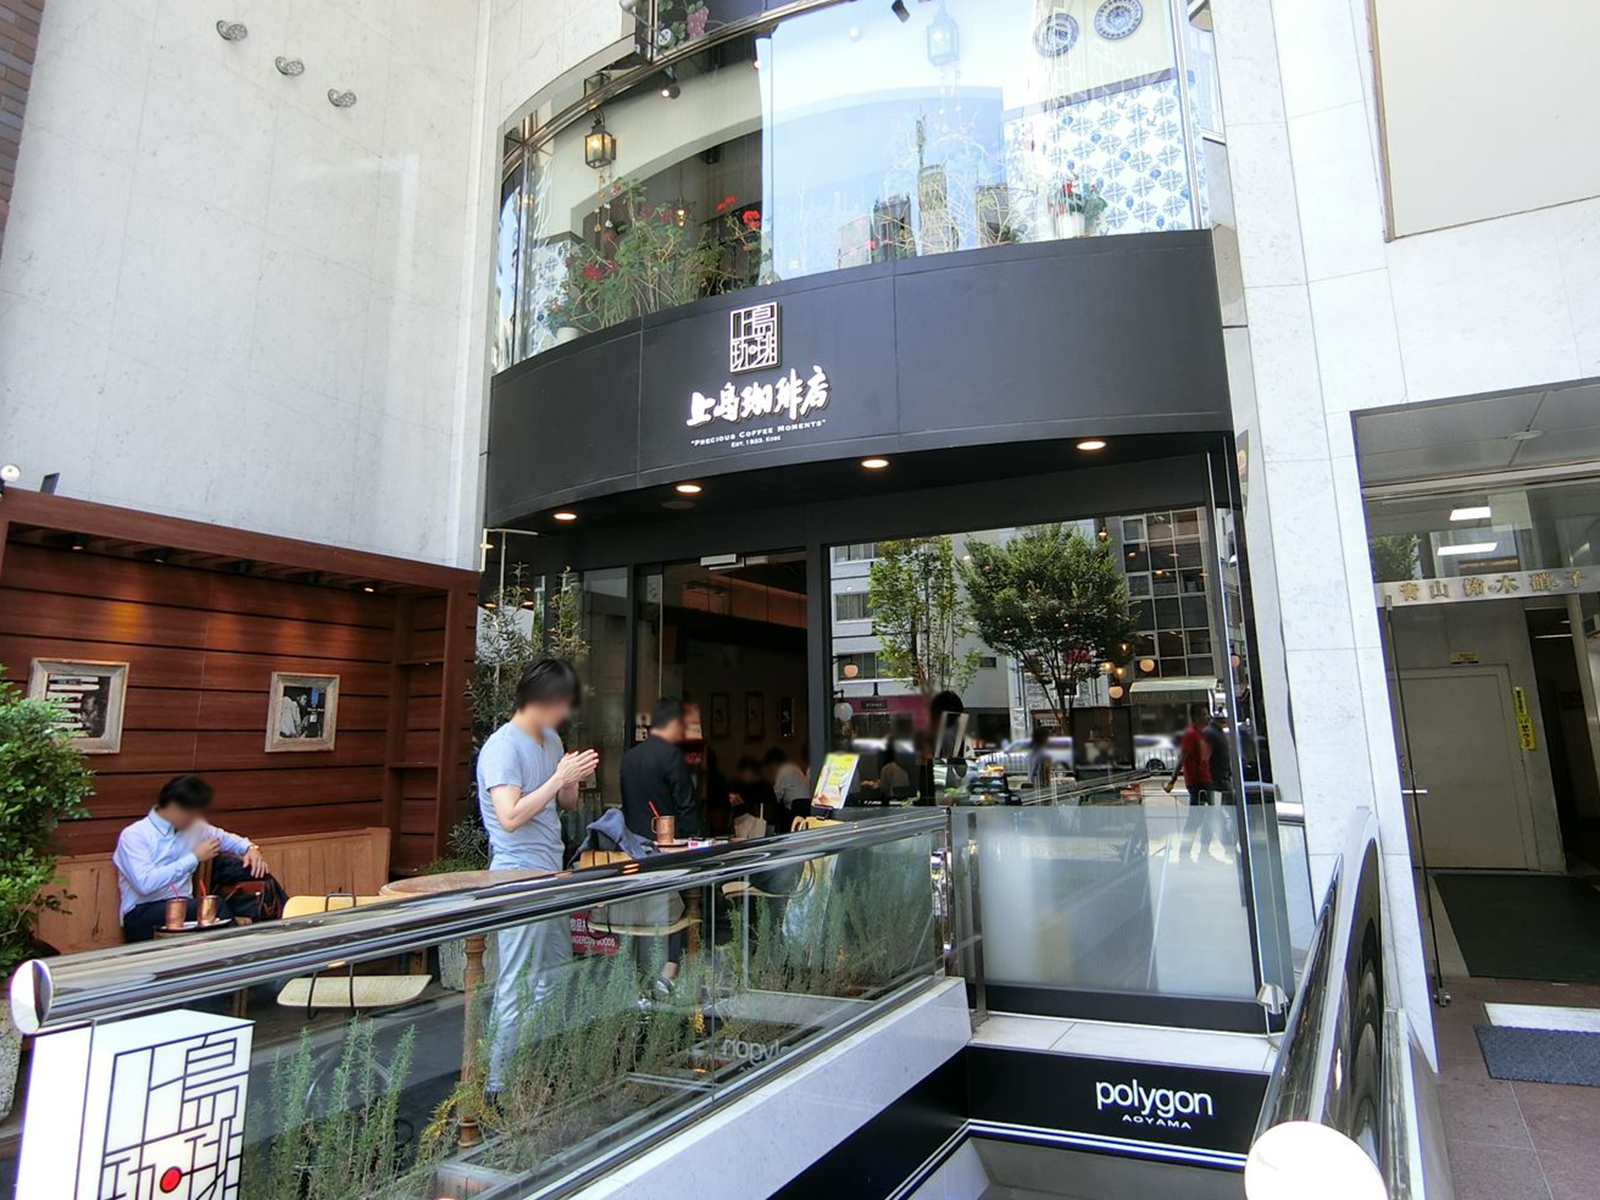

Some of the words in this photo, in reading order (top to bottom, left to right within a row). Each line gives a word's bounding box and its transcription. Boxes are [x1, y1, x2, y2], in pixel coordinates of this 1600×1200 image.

[686, 365, 829, 426] 上島珈琲店
[1096, 1079, 1213, 1118] polygon
[1122, 1114, 1191, 1129] AOYAMA
